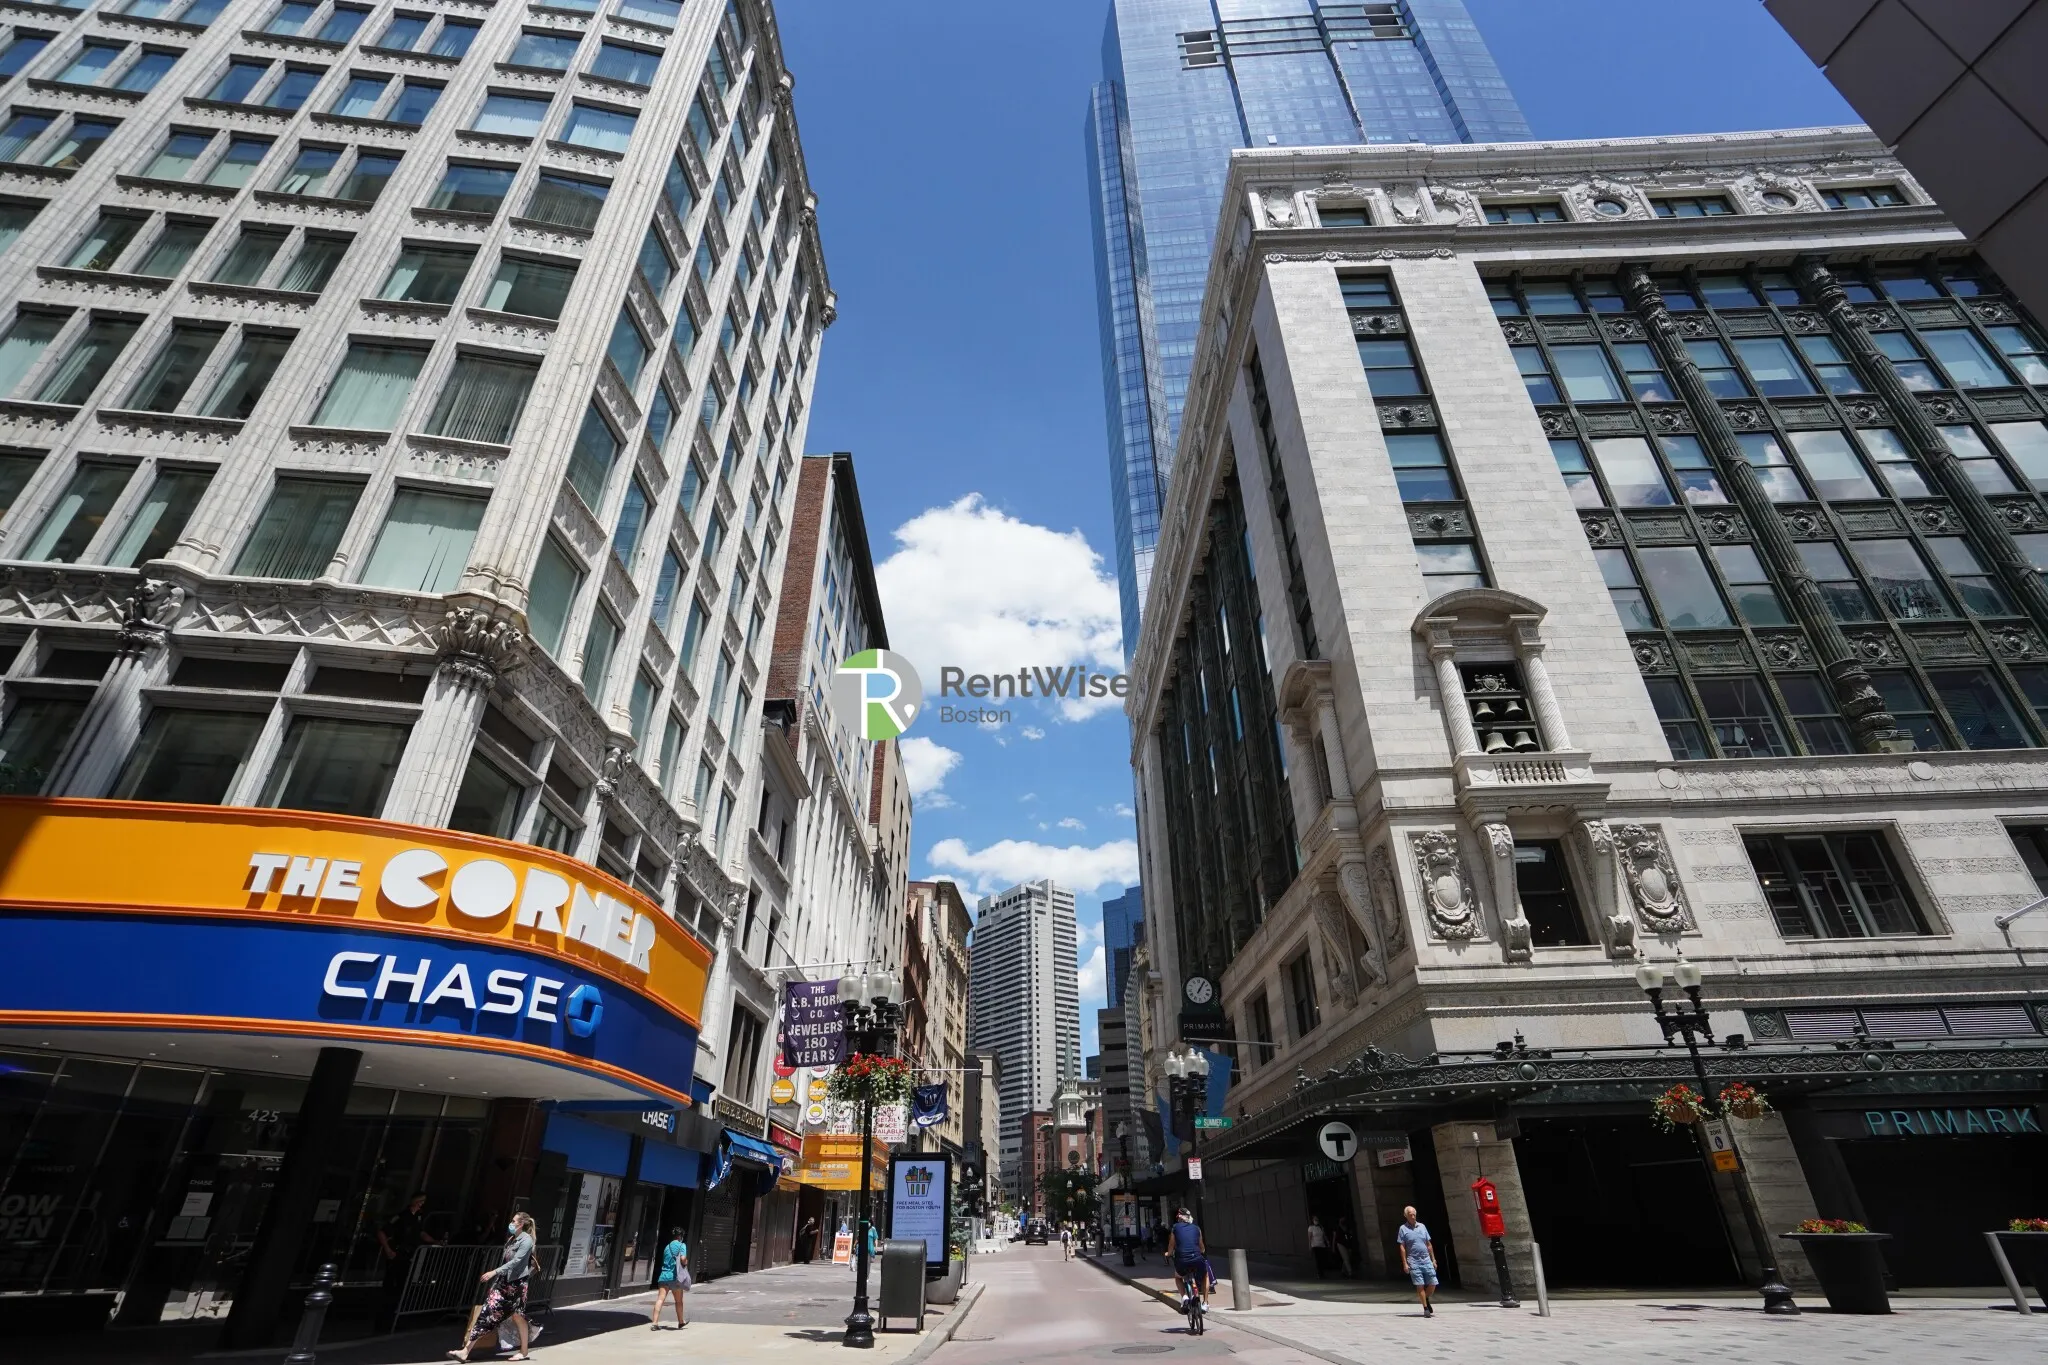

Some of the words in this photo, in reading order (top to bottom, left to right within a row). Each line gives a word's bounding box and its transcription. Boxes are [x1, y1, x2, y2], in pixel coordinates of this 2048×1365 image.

[249, 852, 363, 902] THE
[381, 849, 655, 973] CORNER
[323, 951, 565, 1023] CHASE
[811, 985, 826, 994] THE
[791, 996, 811, 1008] E.B.
[814, 994, 842, 1007] HORN
[809, 1009, 825, 1019] CO.
[788, 1020, 843, 1036] JEWELERS
[1183, 1022, 1221, 1030] PRIMARK
[804, 1036, 828, 1049] 180
[796, 1049, 835, 1064] YEARS
[248, 1108, 280, 1123] 425
[642, 1111, 669, 1129] CHASE
[1203, 1118, 1223, 1127] SUMMER
[1865, 1108, 2042, 1135] PRIMARK
[1325, 1133, 1352, 1157] T
[1362, 1136, 1401, 1145] PRIMARK
